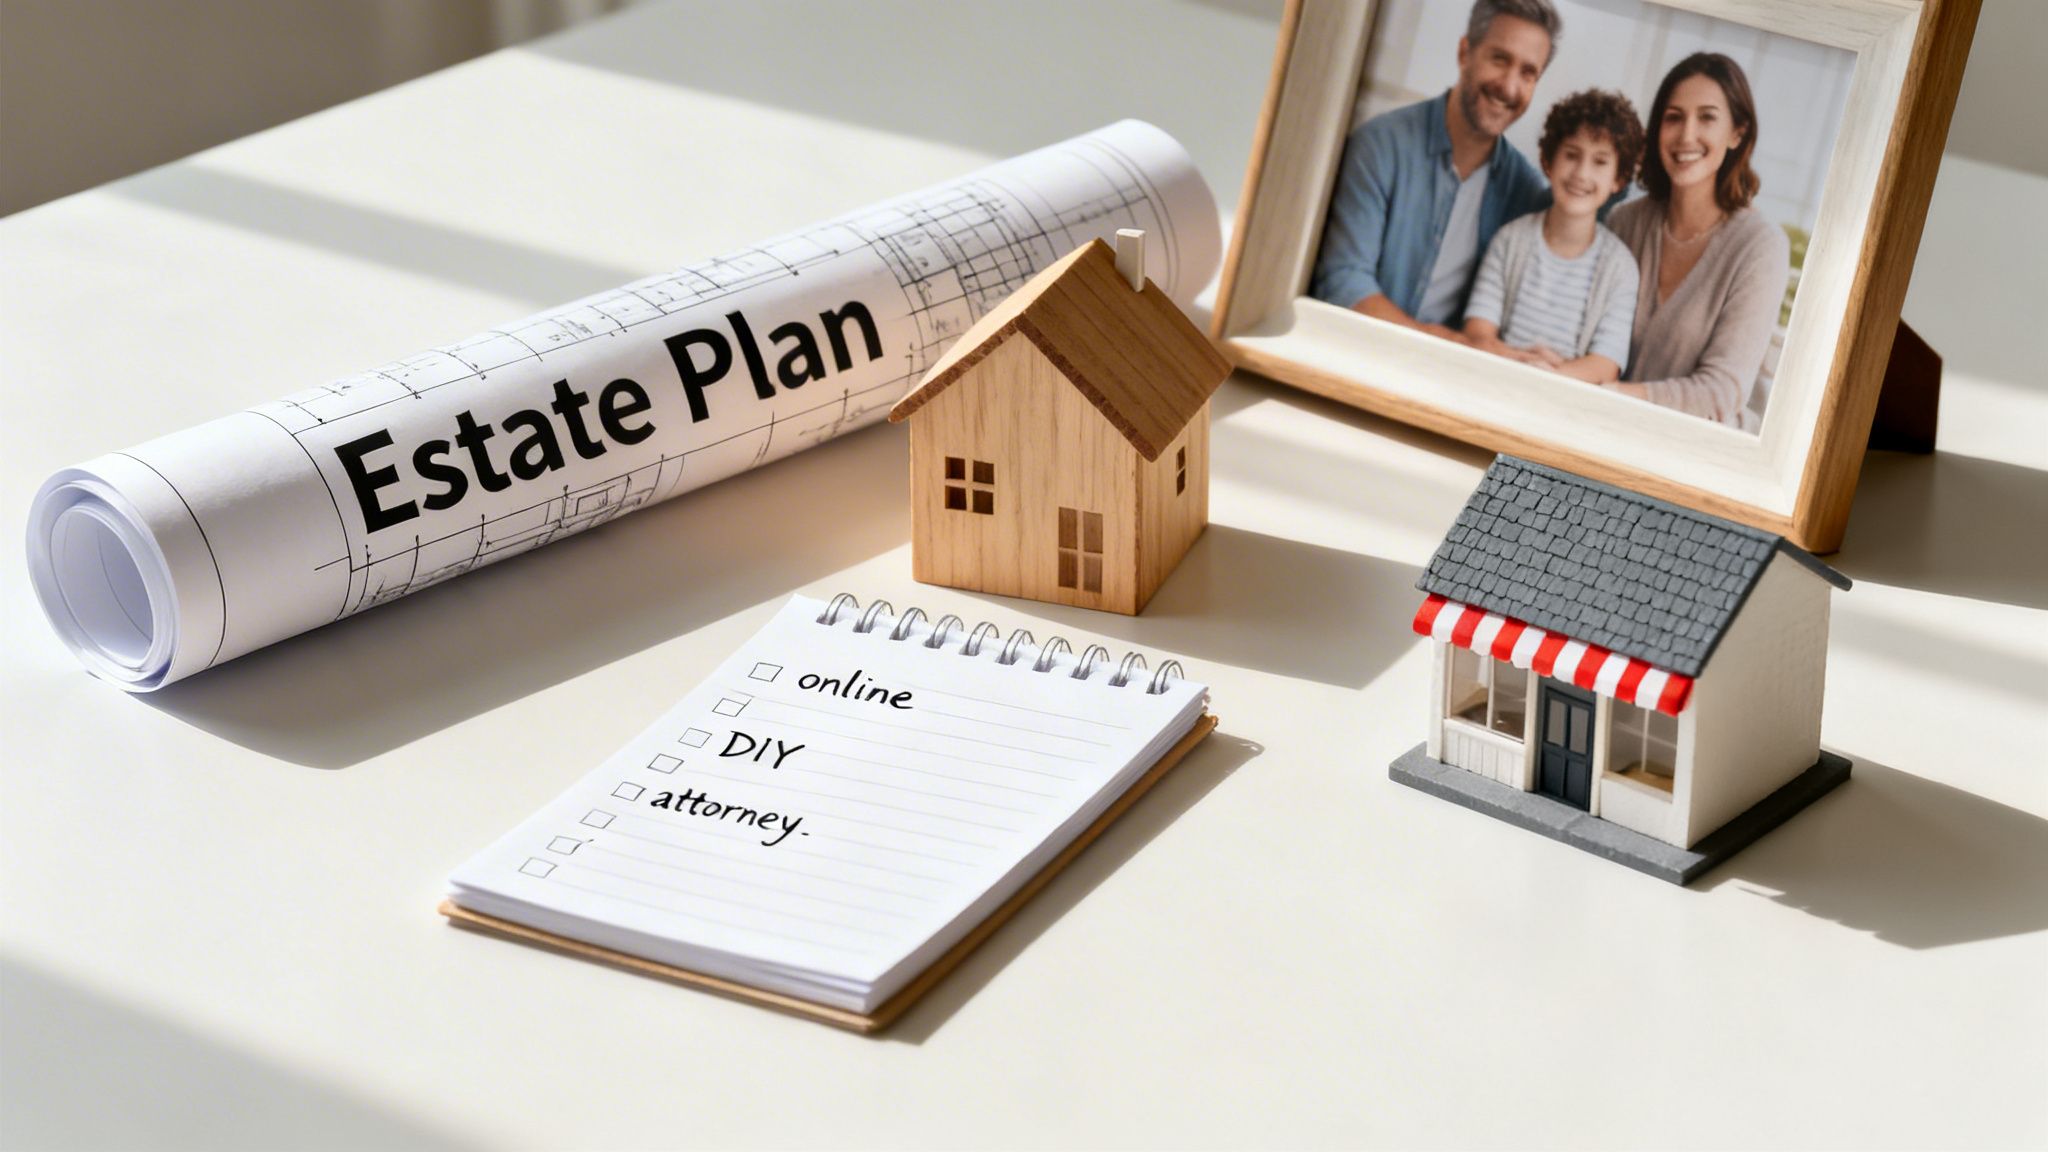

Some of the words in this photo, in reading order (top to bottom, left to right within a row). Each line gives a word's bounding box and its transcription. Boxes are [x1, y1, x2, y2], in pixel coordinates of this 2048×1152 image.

[333, 377, 656, 535] Estate
[663, 300, 884, 424] Plan
[797, 669, 914, 710] online
[717, 730, 806, 770] DIY
